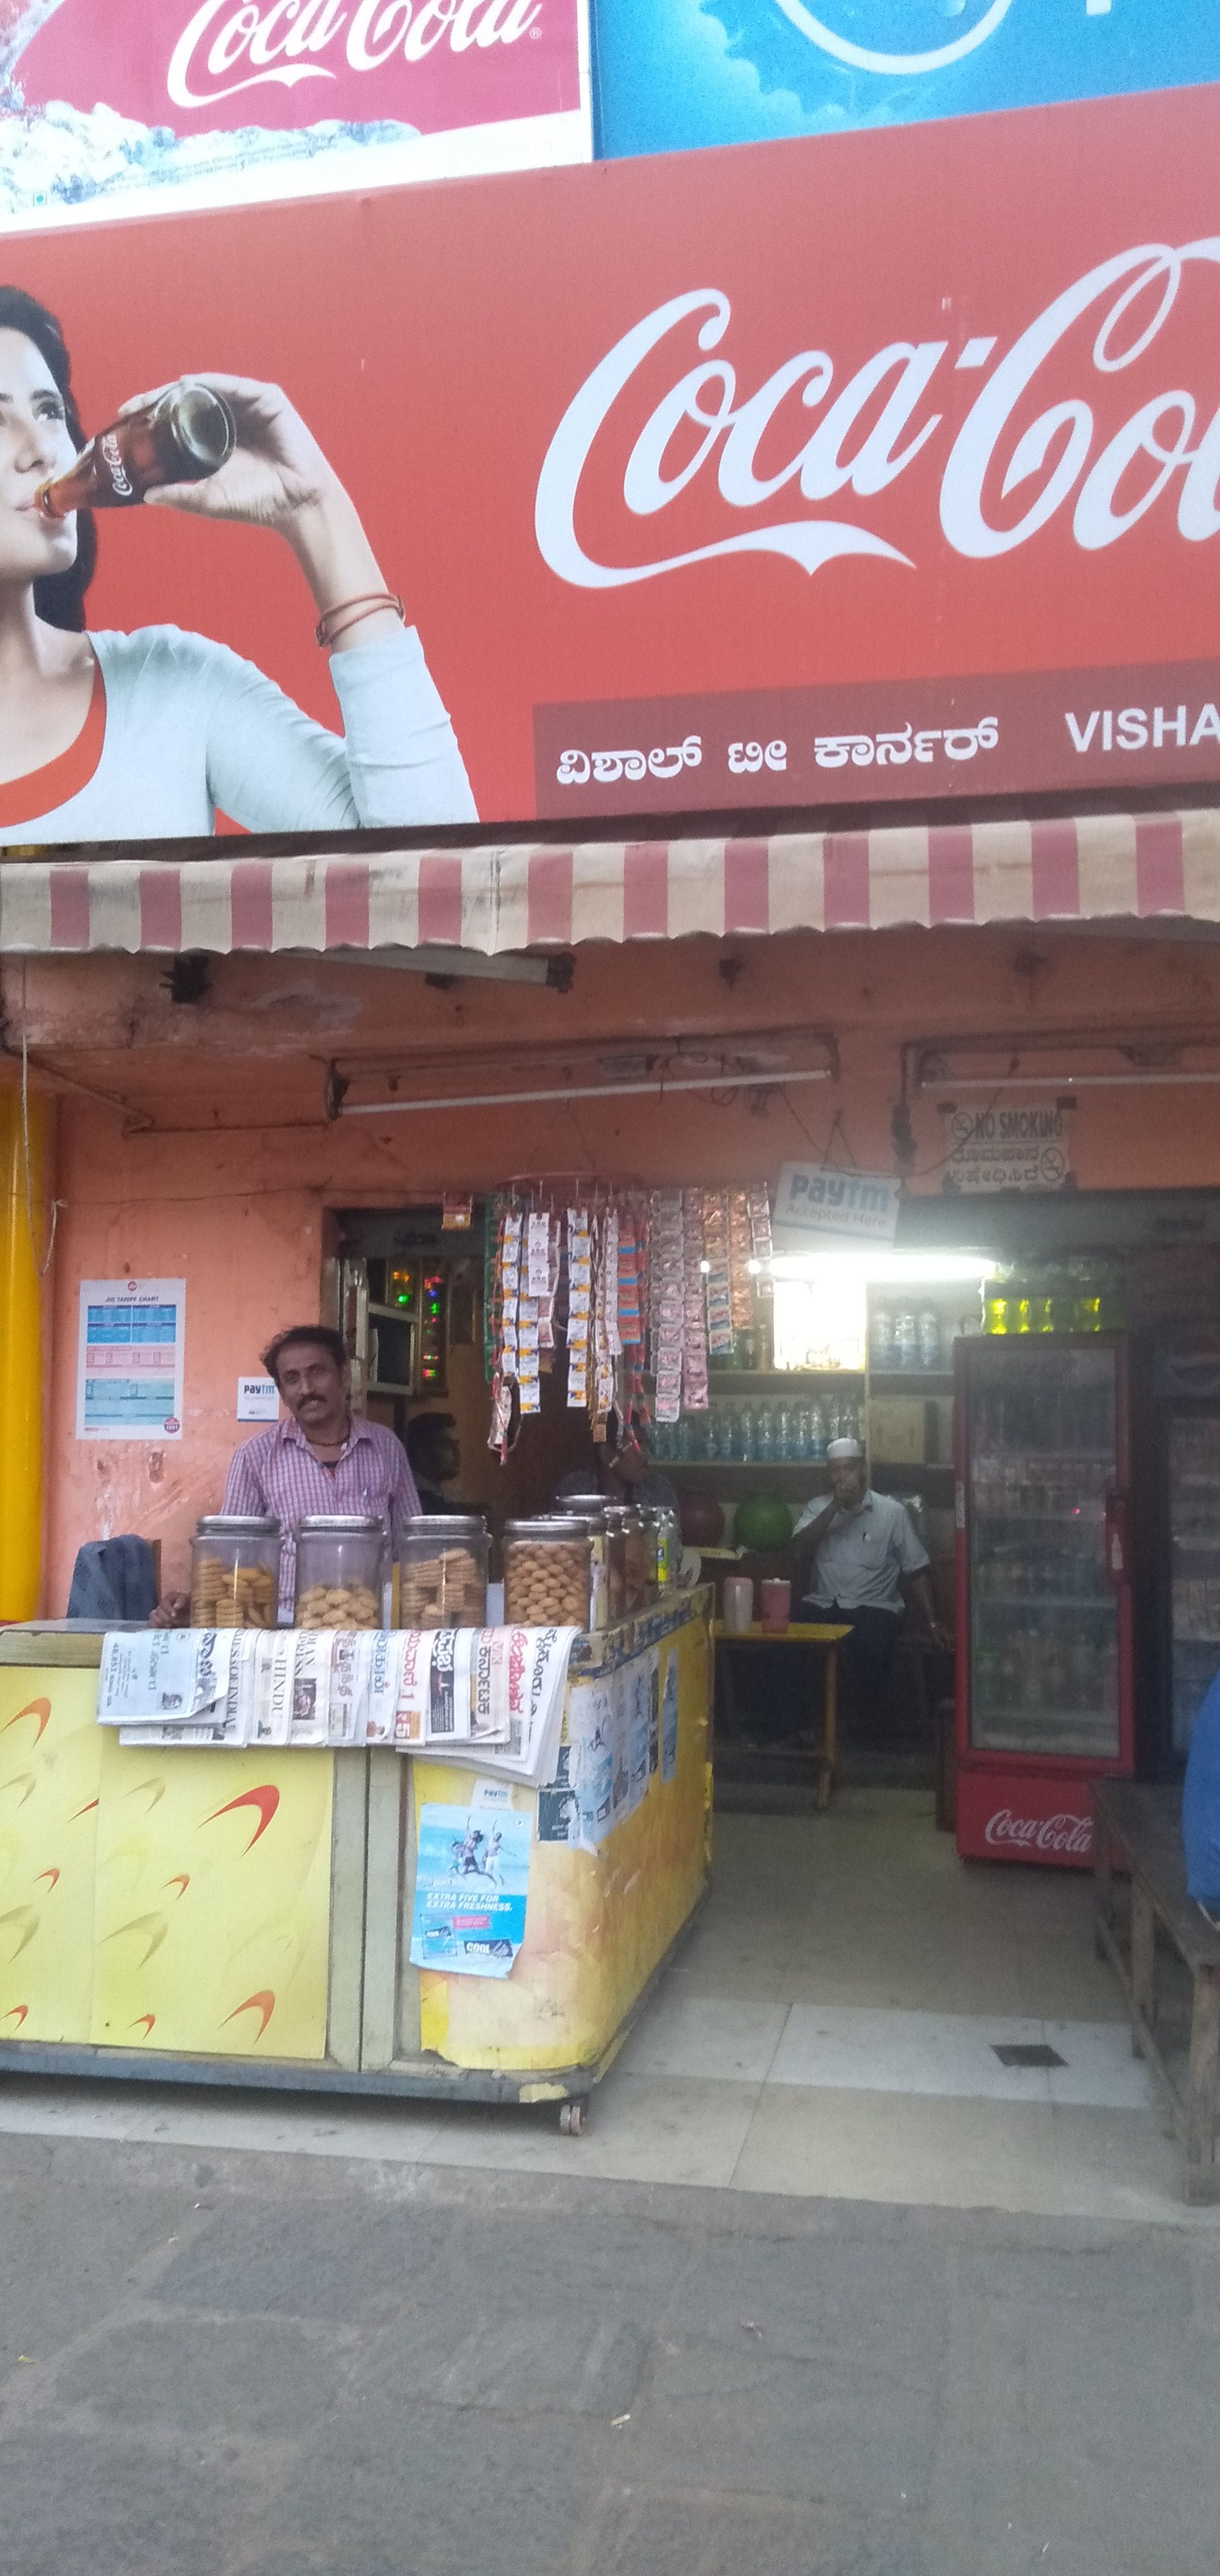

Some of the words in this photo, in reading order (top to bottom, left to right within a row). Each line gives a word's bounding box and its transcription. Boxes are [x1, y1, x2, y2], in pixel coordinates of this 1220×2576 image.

[556, 734, 701, 784] ವಿಶಾಲ್
[728, 736, 788, 773] ಟೀ
[814, 716, 998, 768] ಕಾರ್ನರ್
[1065, 703, 1220, 753] VISHA
[975, 1112, 995, 1139] NO
[1000, 1110, 1063, 1139] SMOKING
[272, 1660, 287, 1717] HINDU
[477, 1646, 491, 1714] ಕರ್ನಾಟಕ
[986, 1809, 1094, 1853] Coca-Cola
[426, 1901, 456, 1909] EXTRA
[427, 1892, 456, 1900] EXTRA
[466, 1942, 490, 1954] COOL
